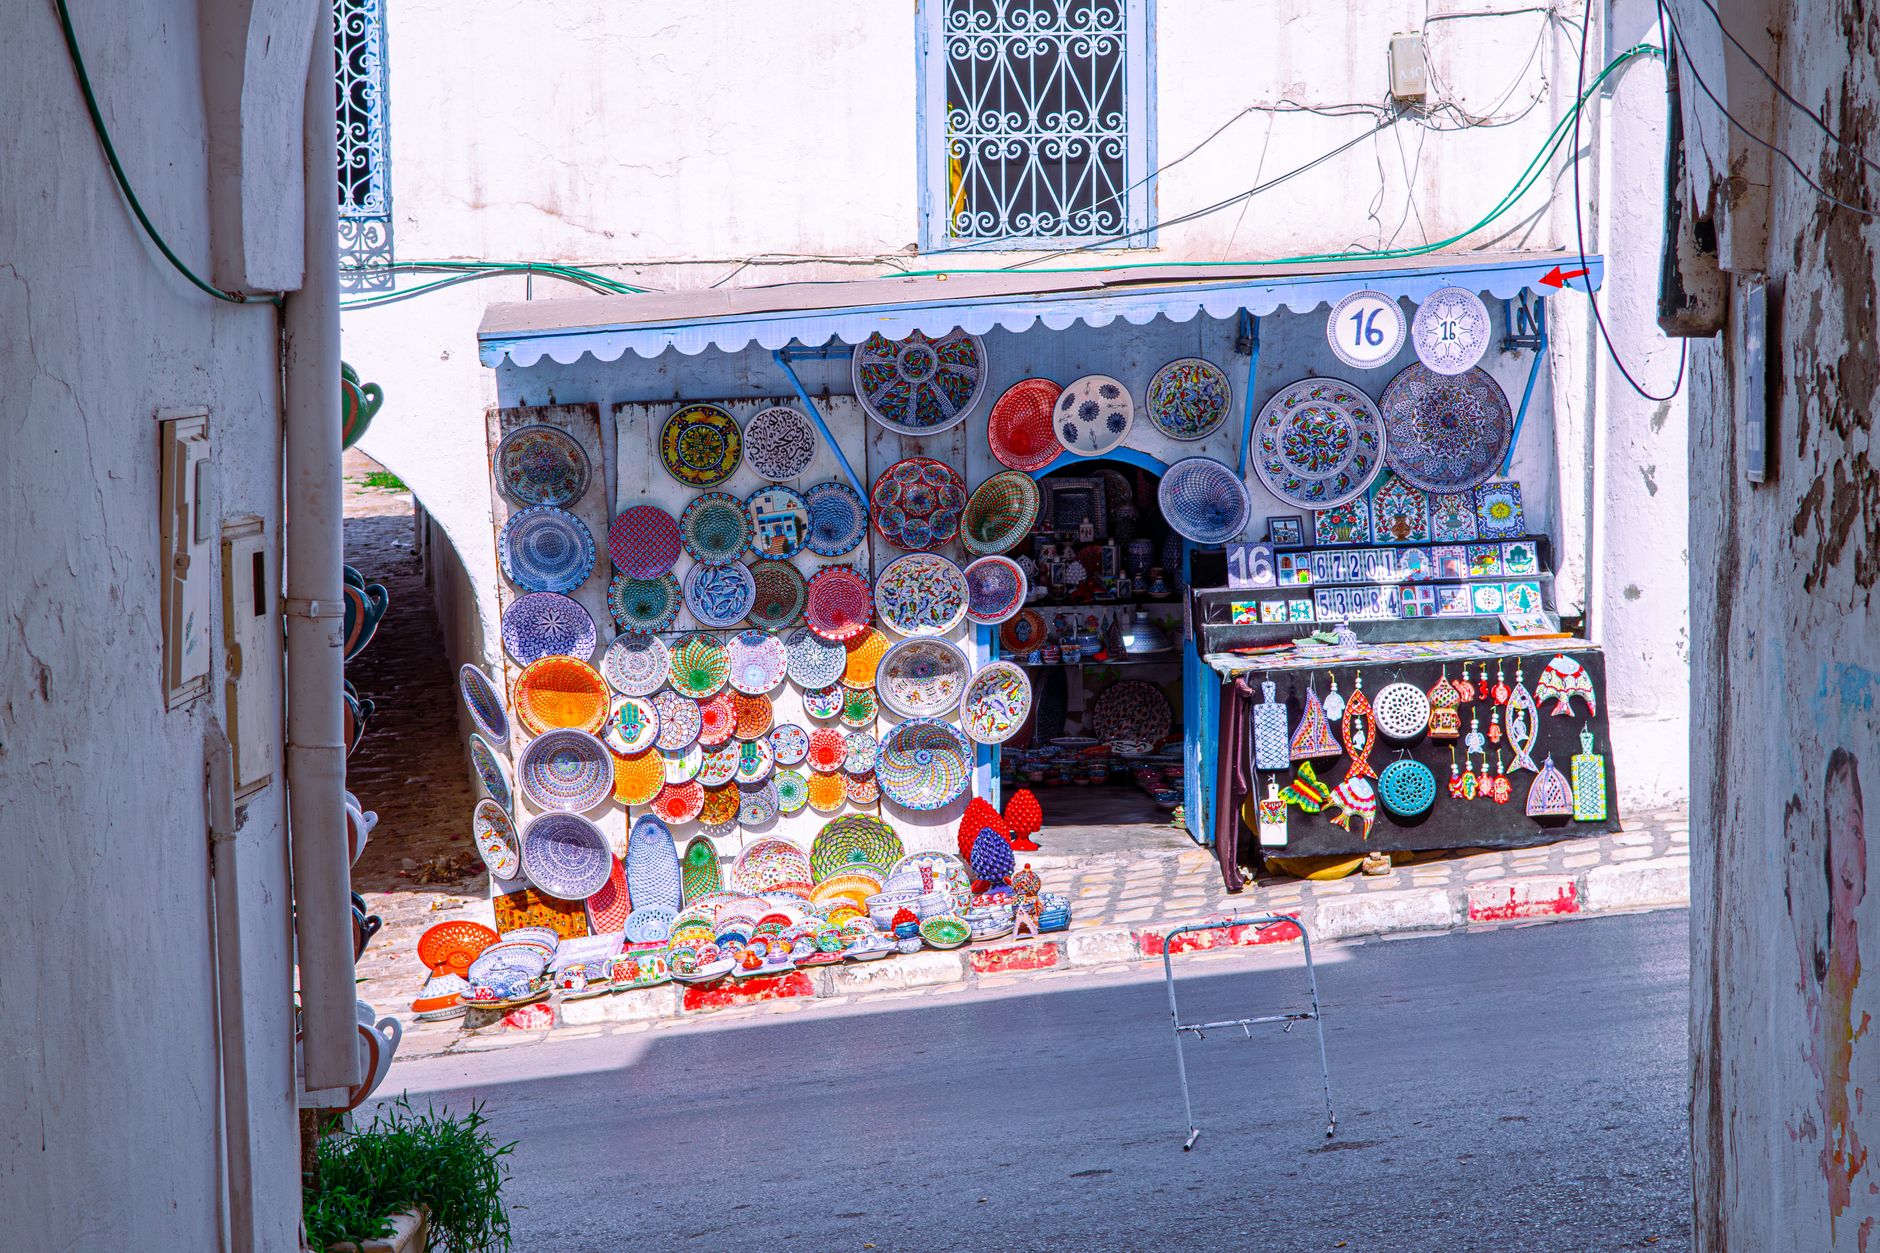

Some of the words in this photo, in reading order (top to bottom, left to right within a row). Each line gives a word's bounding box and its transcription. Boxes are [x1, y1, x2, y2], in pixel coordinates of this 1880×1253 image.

[1349, 307, 1384, 346] 16
[1439, 320, 1457, 341] 16
[1229, 546, 1272, 584] 16
